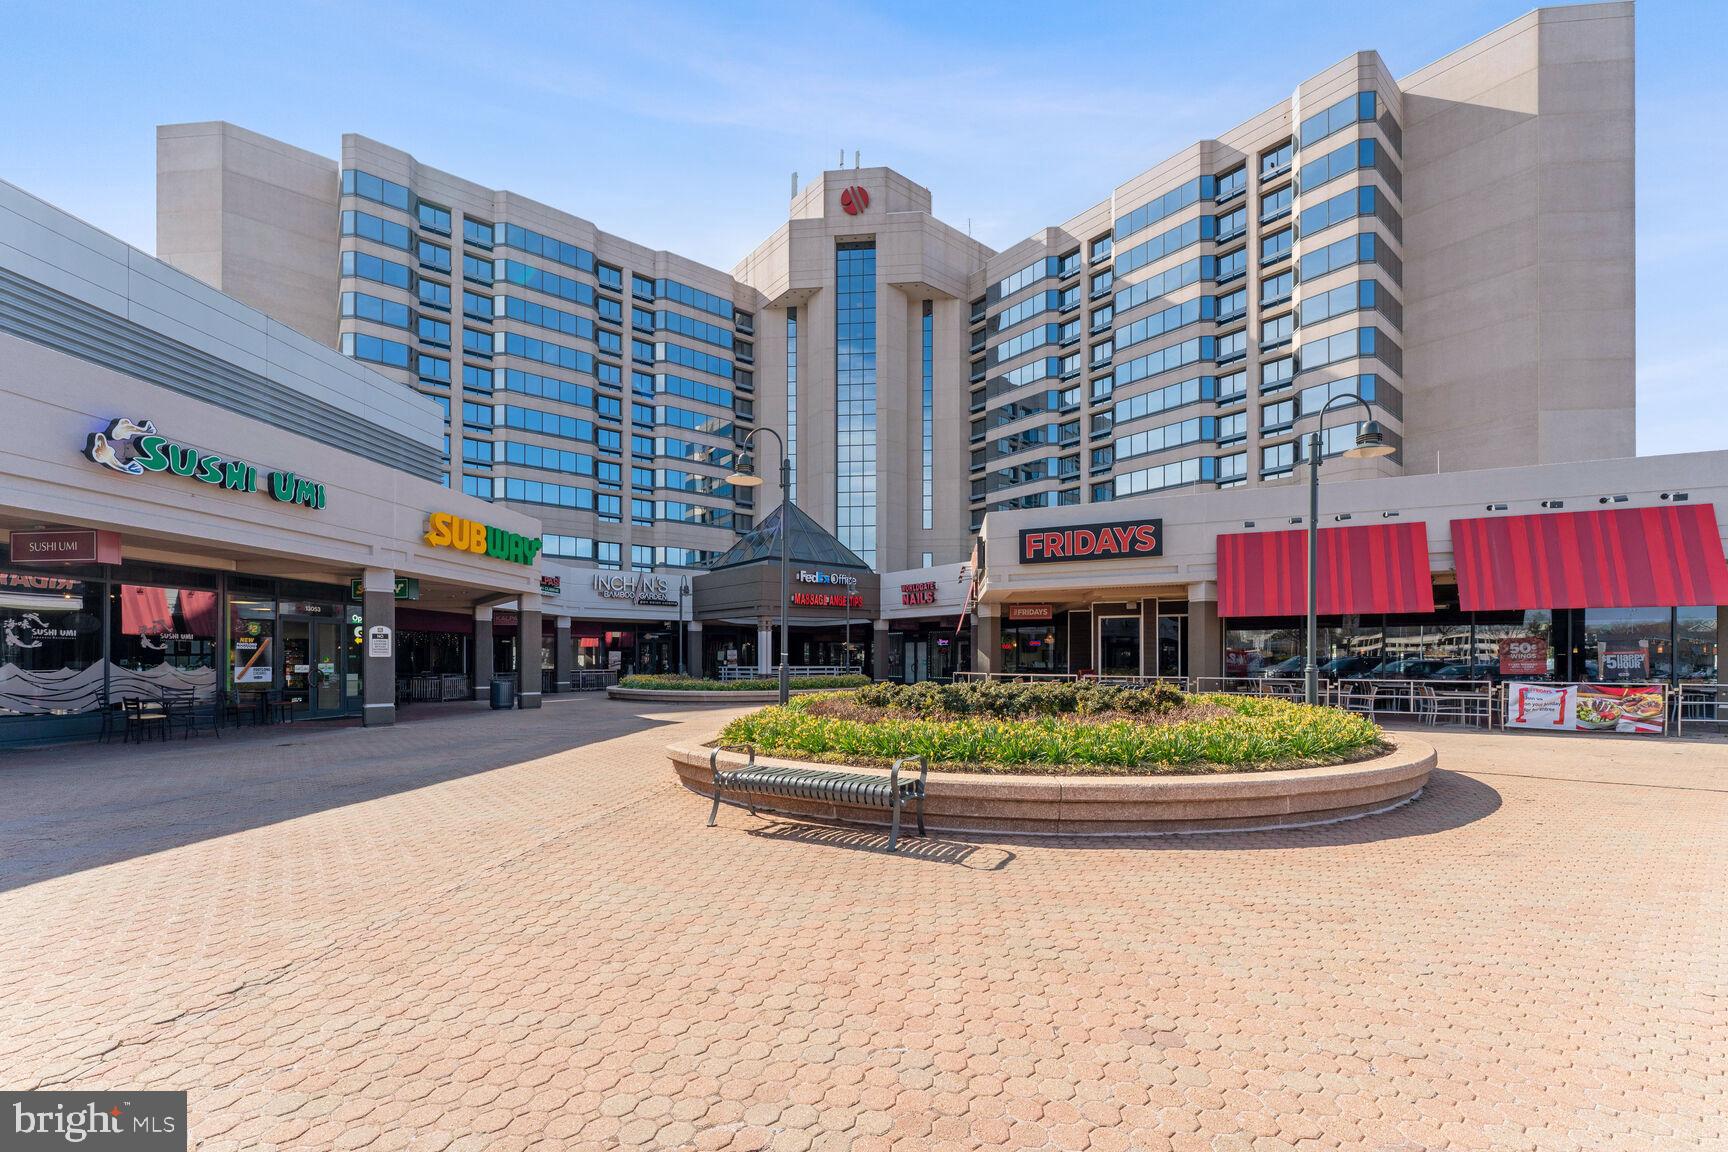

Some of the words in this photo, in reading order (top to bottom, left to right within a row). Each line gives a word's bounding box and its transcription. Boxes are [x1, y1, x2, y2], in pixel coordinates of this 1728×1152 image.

[133, 436, 257, 492] SUSHI
[267, 471, 326, 509] UMI
[424, 512, 542, 566] SUBWAY
[1026, 525, 1157, 559] FRIDAYS
[29, 542, 57, 552] SUSHI
[59, 541, 78, 551] UMI
[800, 570, 830, 584] FedEx
[831, 573, 857, 585] Office
[603, 590, 635, 599] BAMBOO
[640, 592, 667, 600] GARDEN
[794, 593, 829, 606] MASSAGE
[902, 592, 934, 606] NAILS
[1018, 608, 1048, 616] FRIDAYS
[32, 628, 57, 636] SUSHI
[60, 629, 77, 637] UMI
[160, 632, 179, 640] SUSHI
[1617, 660, 1641, 669] HOUR
